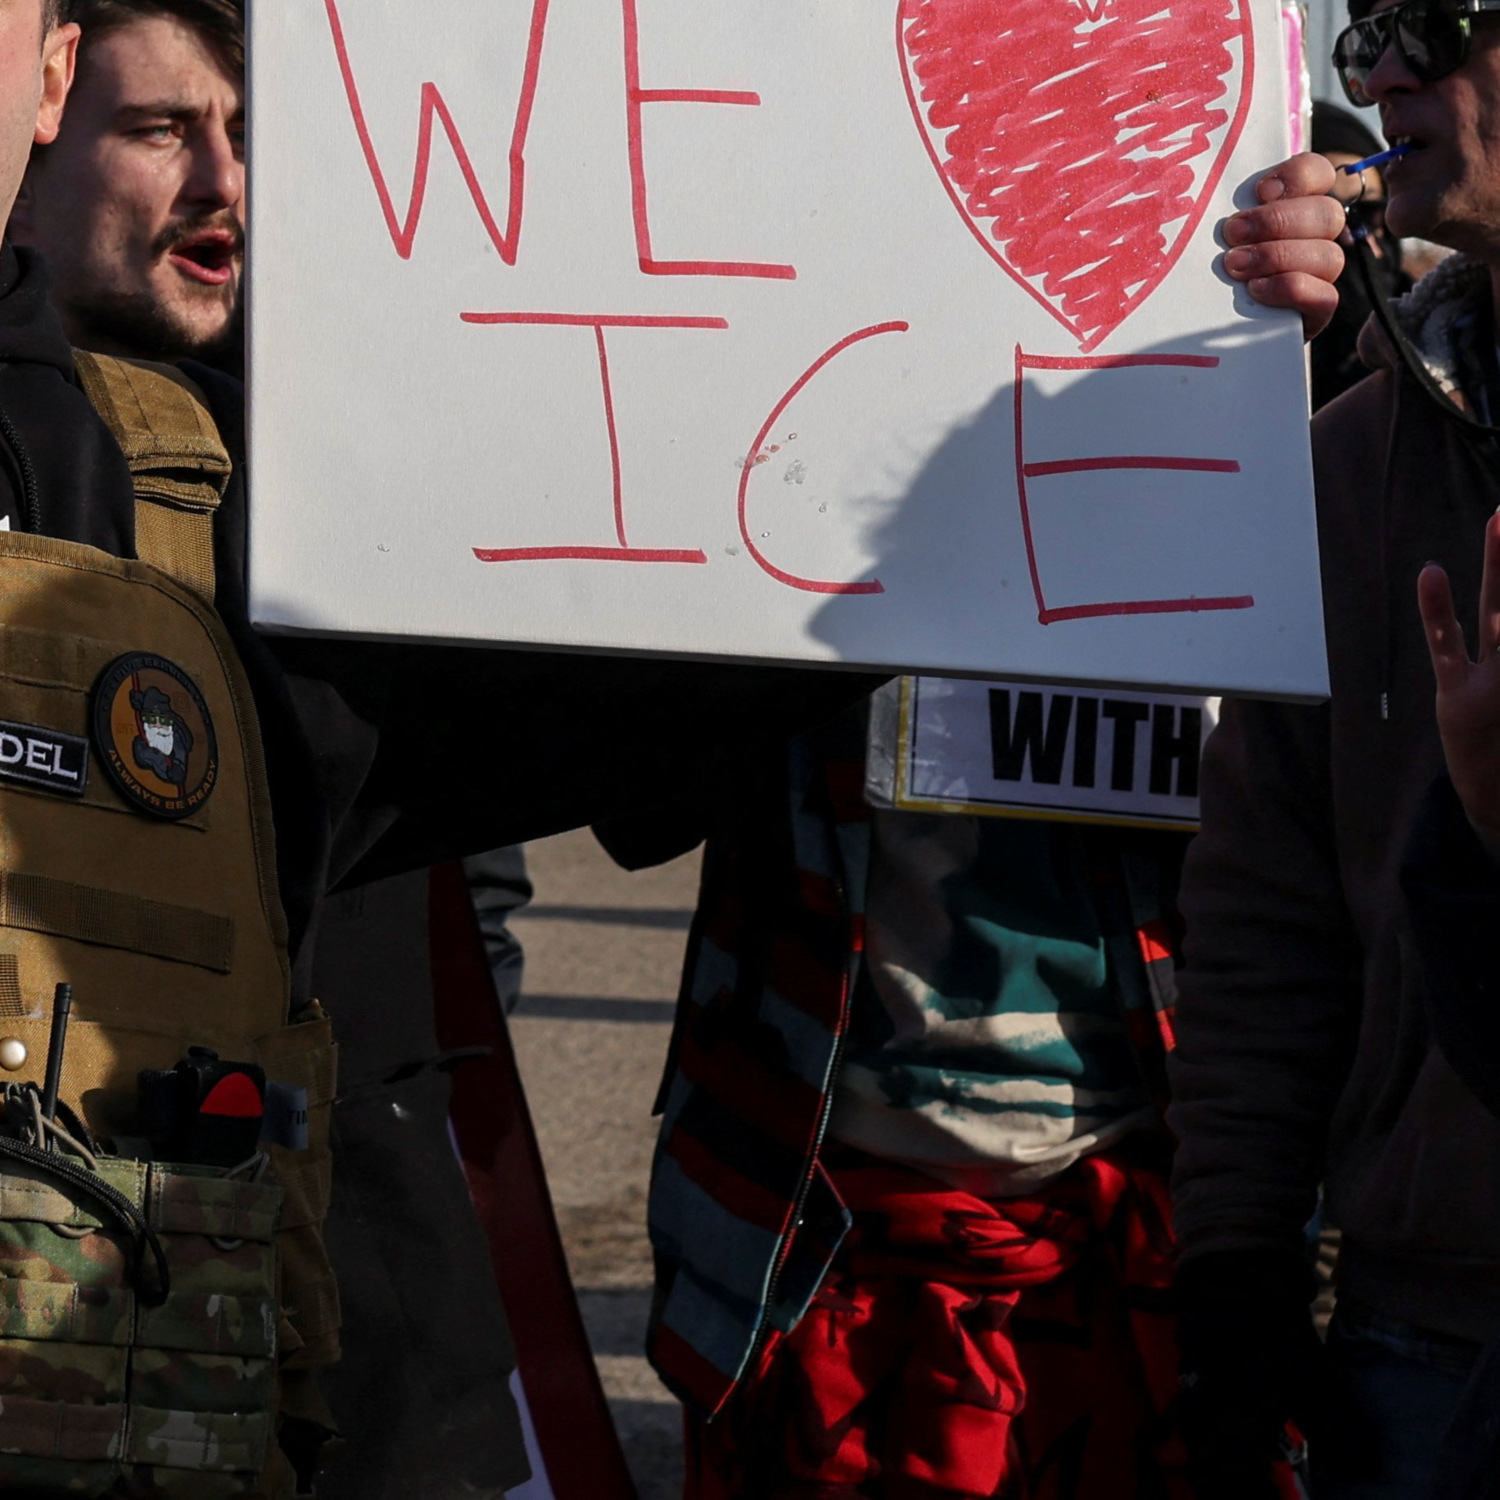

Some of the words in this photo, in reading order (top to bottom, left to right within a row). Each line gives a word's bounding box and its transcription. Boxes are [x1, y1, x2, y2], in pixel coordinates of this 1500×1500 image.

[459, 311, 1256, 626] ICE
[108, 749, 161, 807] ALWAYS
[165, 800, 185, 811] BE
[187, 760, 217, 807] READY
[988, 687, 1201, 798] WITH
